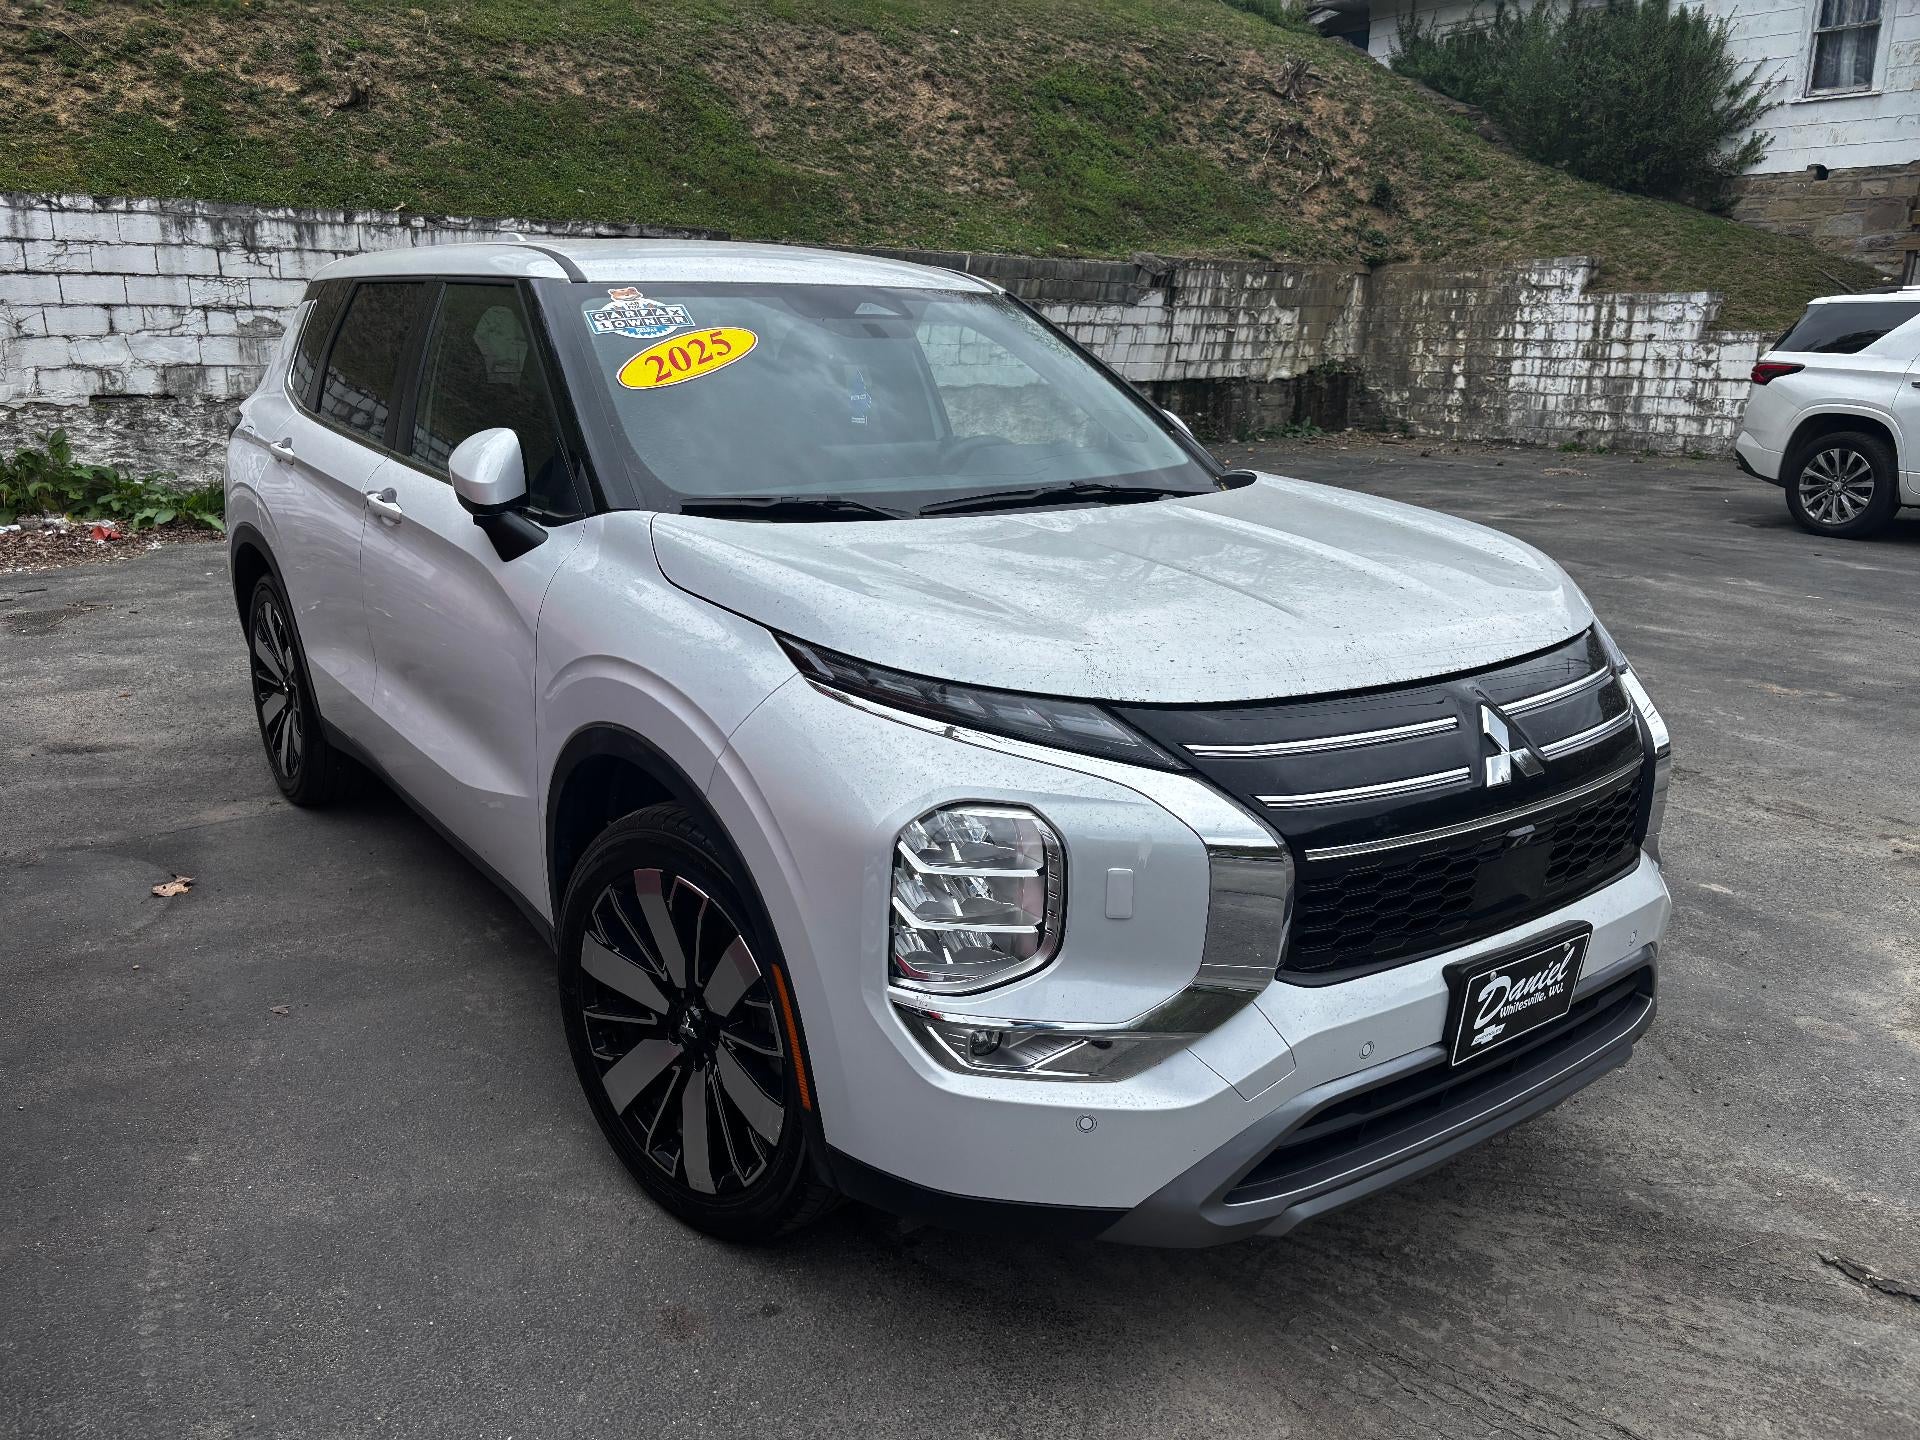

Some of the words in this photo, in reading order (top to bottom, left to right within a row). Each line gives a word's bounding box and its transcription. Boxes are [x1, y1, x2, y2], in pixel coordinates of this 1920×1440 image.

[594, 308, 680, 320] CARFAX
[644, 331, 732, 383] 2025
[1473, 946, 1576, 1030] Daniel
